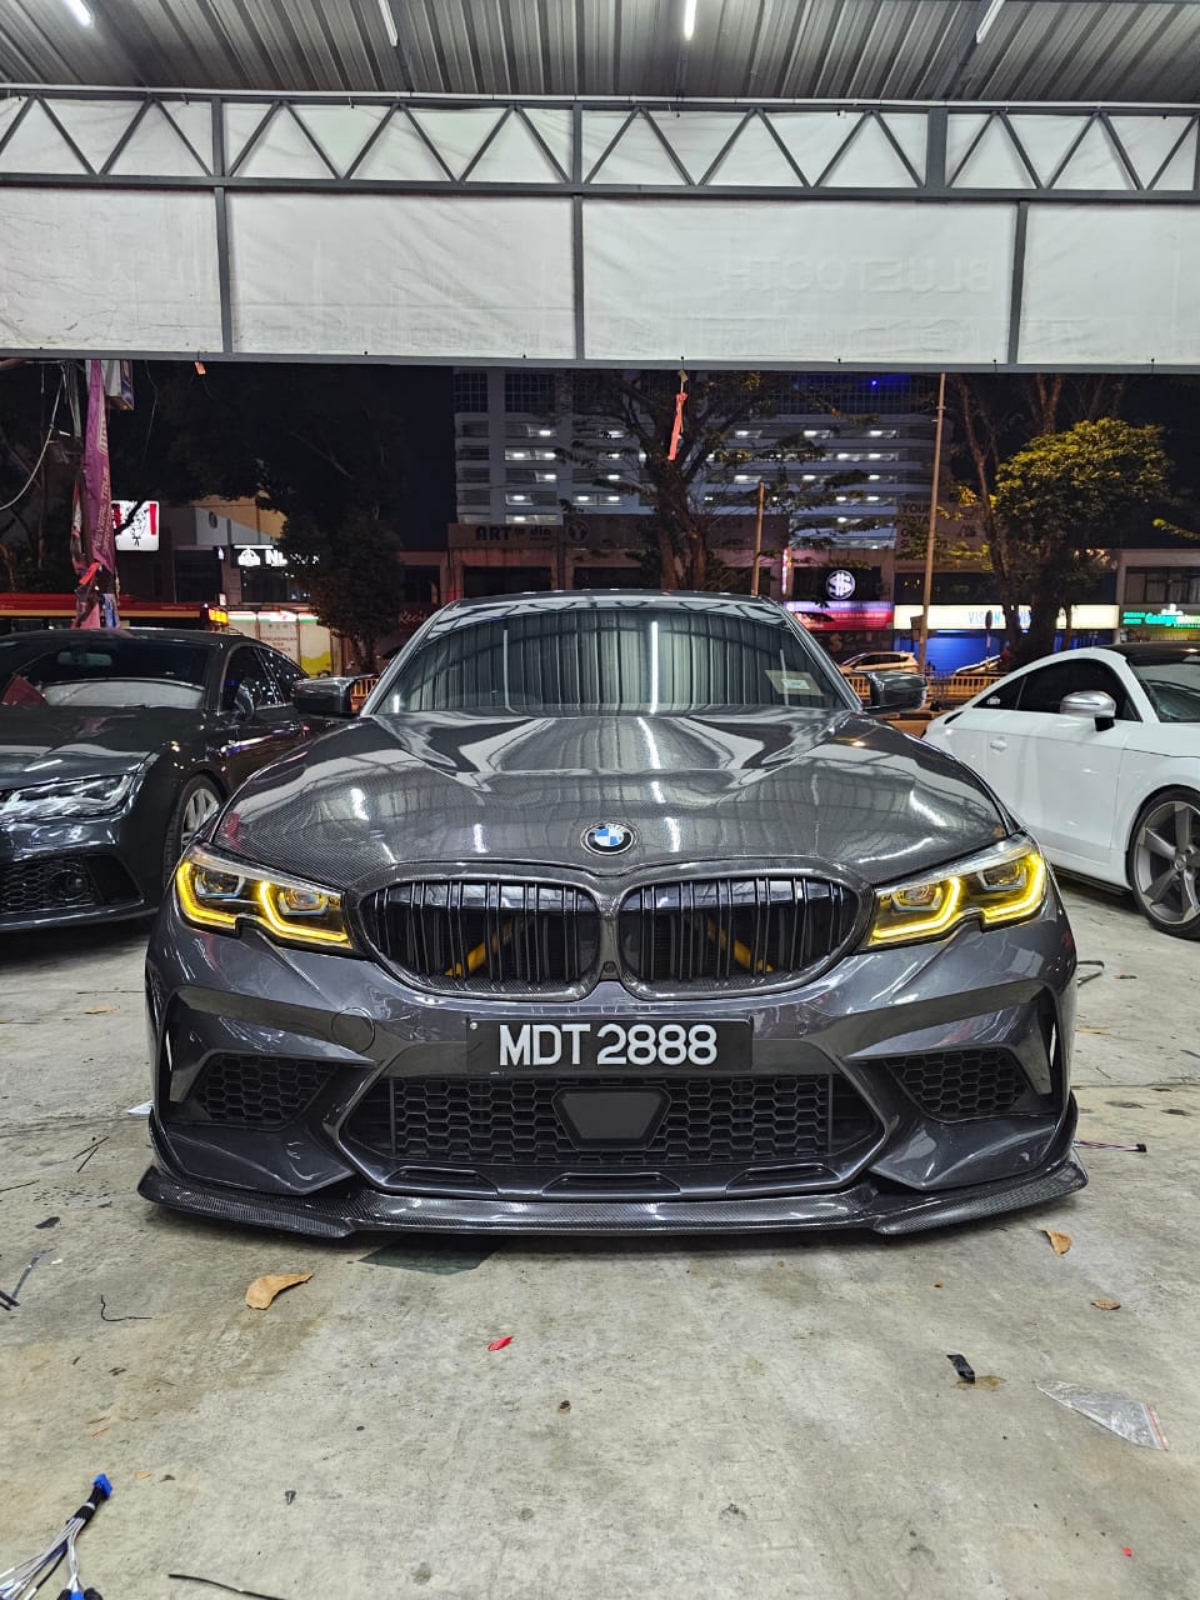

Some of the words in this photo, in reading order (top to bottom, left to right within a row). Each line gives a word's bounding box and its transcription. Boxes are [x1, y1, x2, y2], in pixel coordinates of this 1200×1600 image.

[475, 525, 512, 541] ART
[499, 1023, 591, 1066] MDT
[597, 1023, 718, 1066] 2888
